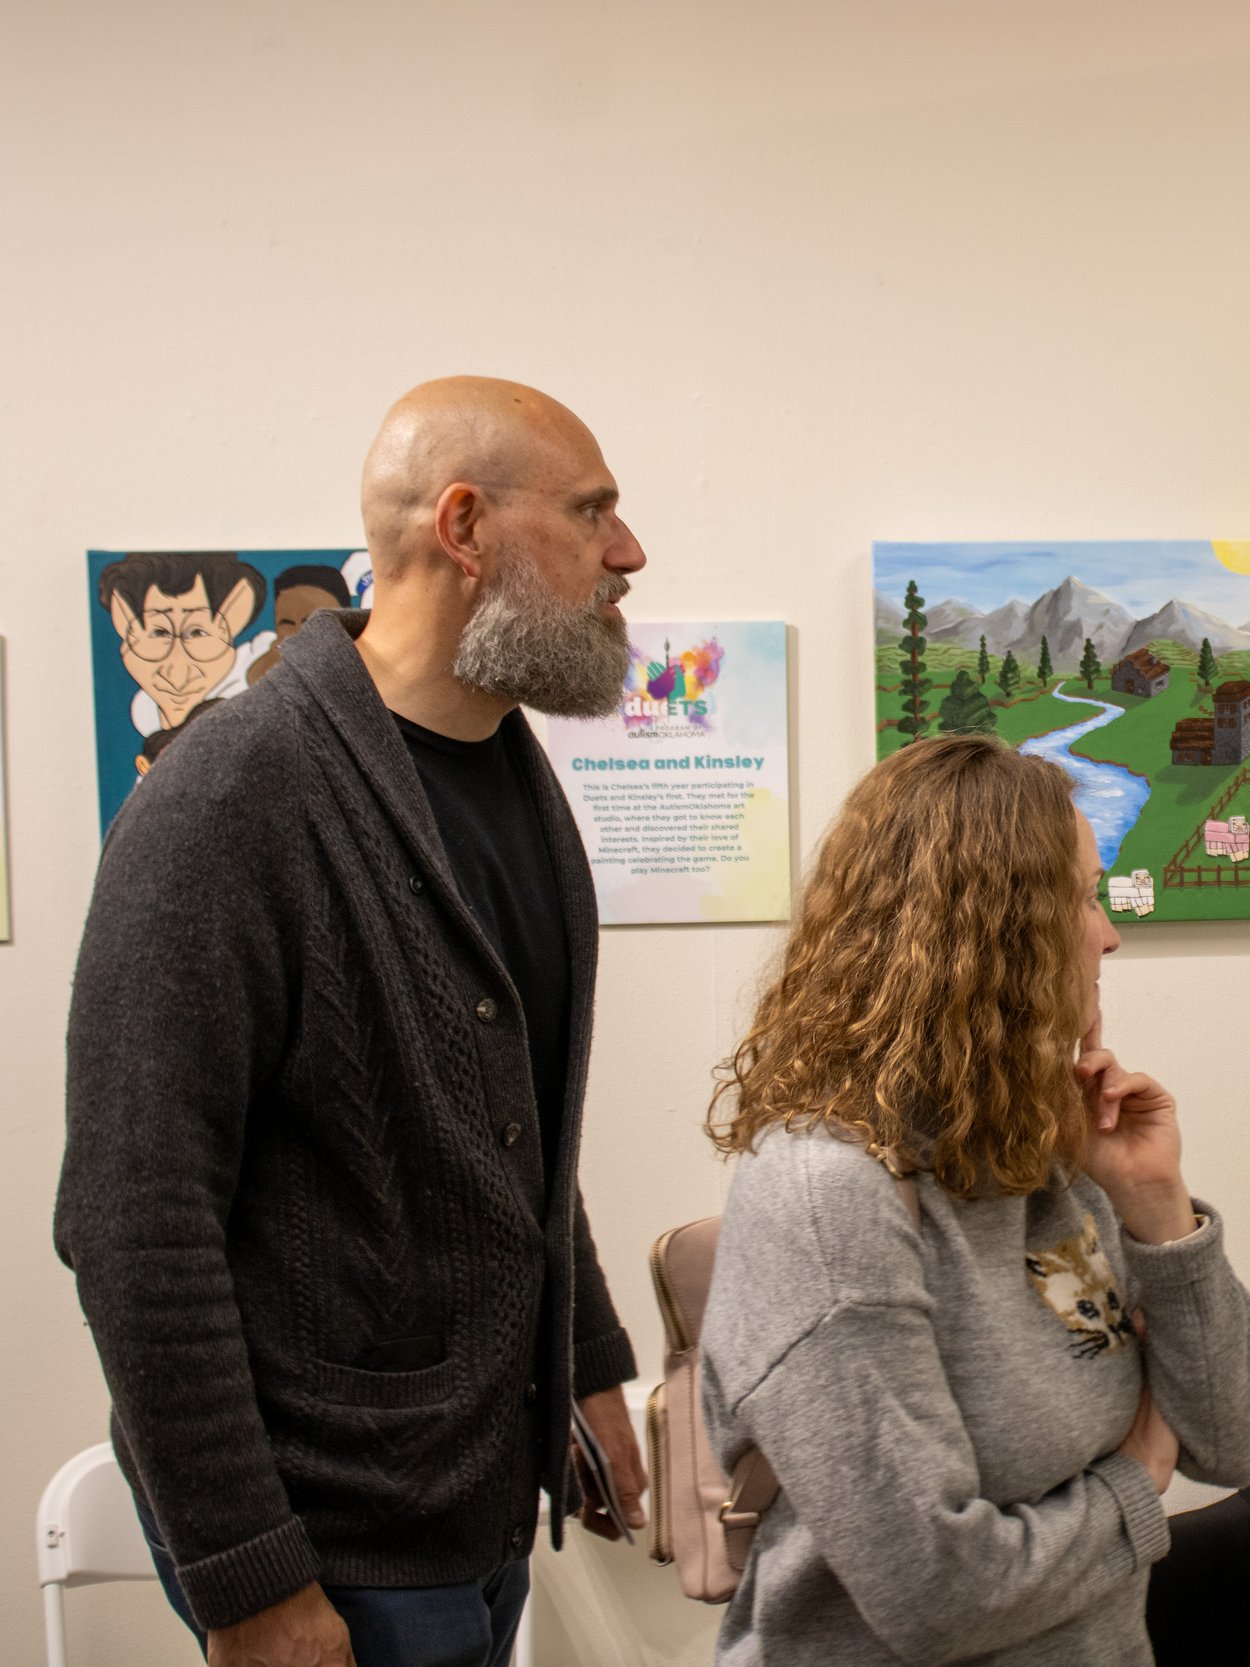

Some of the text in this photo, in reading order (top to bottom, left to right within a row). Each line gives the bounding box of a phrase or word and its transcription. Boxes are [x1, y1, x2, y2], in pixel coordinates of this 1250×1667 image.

[572, 754, 764, 772] Chelsea and Kinsley
[691, 782, 744, 790] participating
[677, 835, 687, 843] by
[598, 846, 639, 854] Minecraft,
[642, 846, 660, 854] they
[591, 857, 625, 865] painting
[628, 856, 674, 864] celebrating
[650, 866, 689, 874] Minecraft
